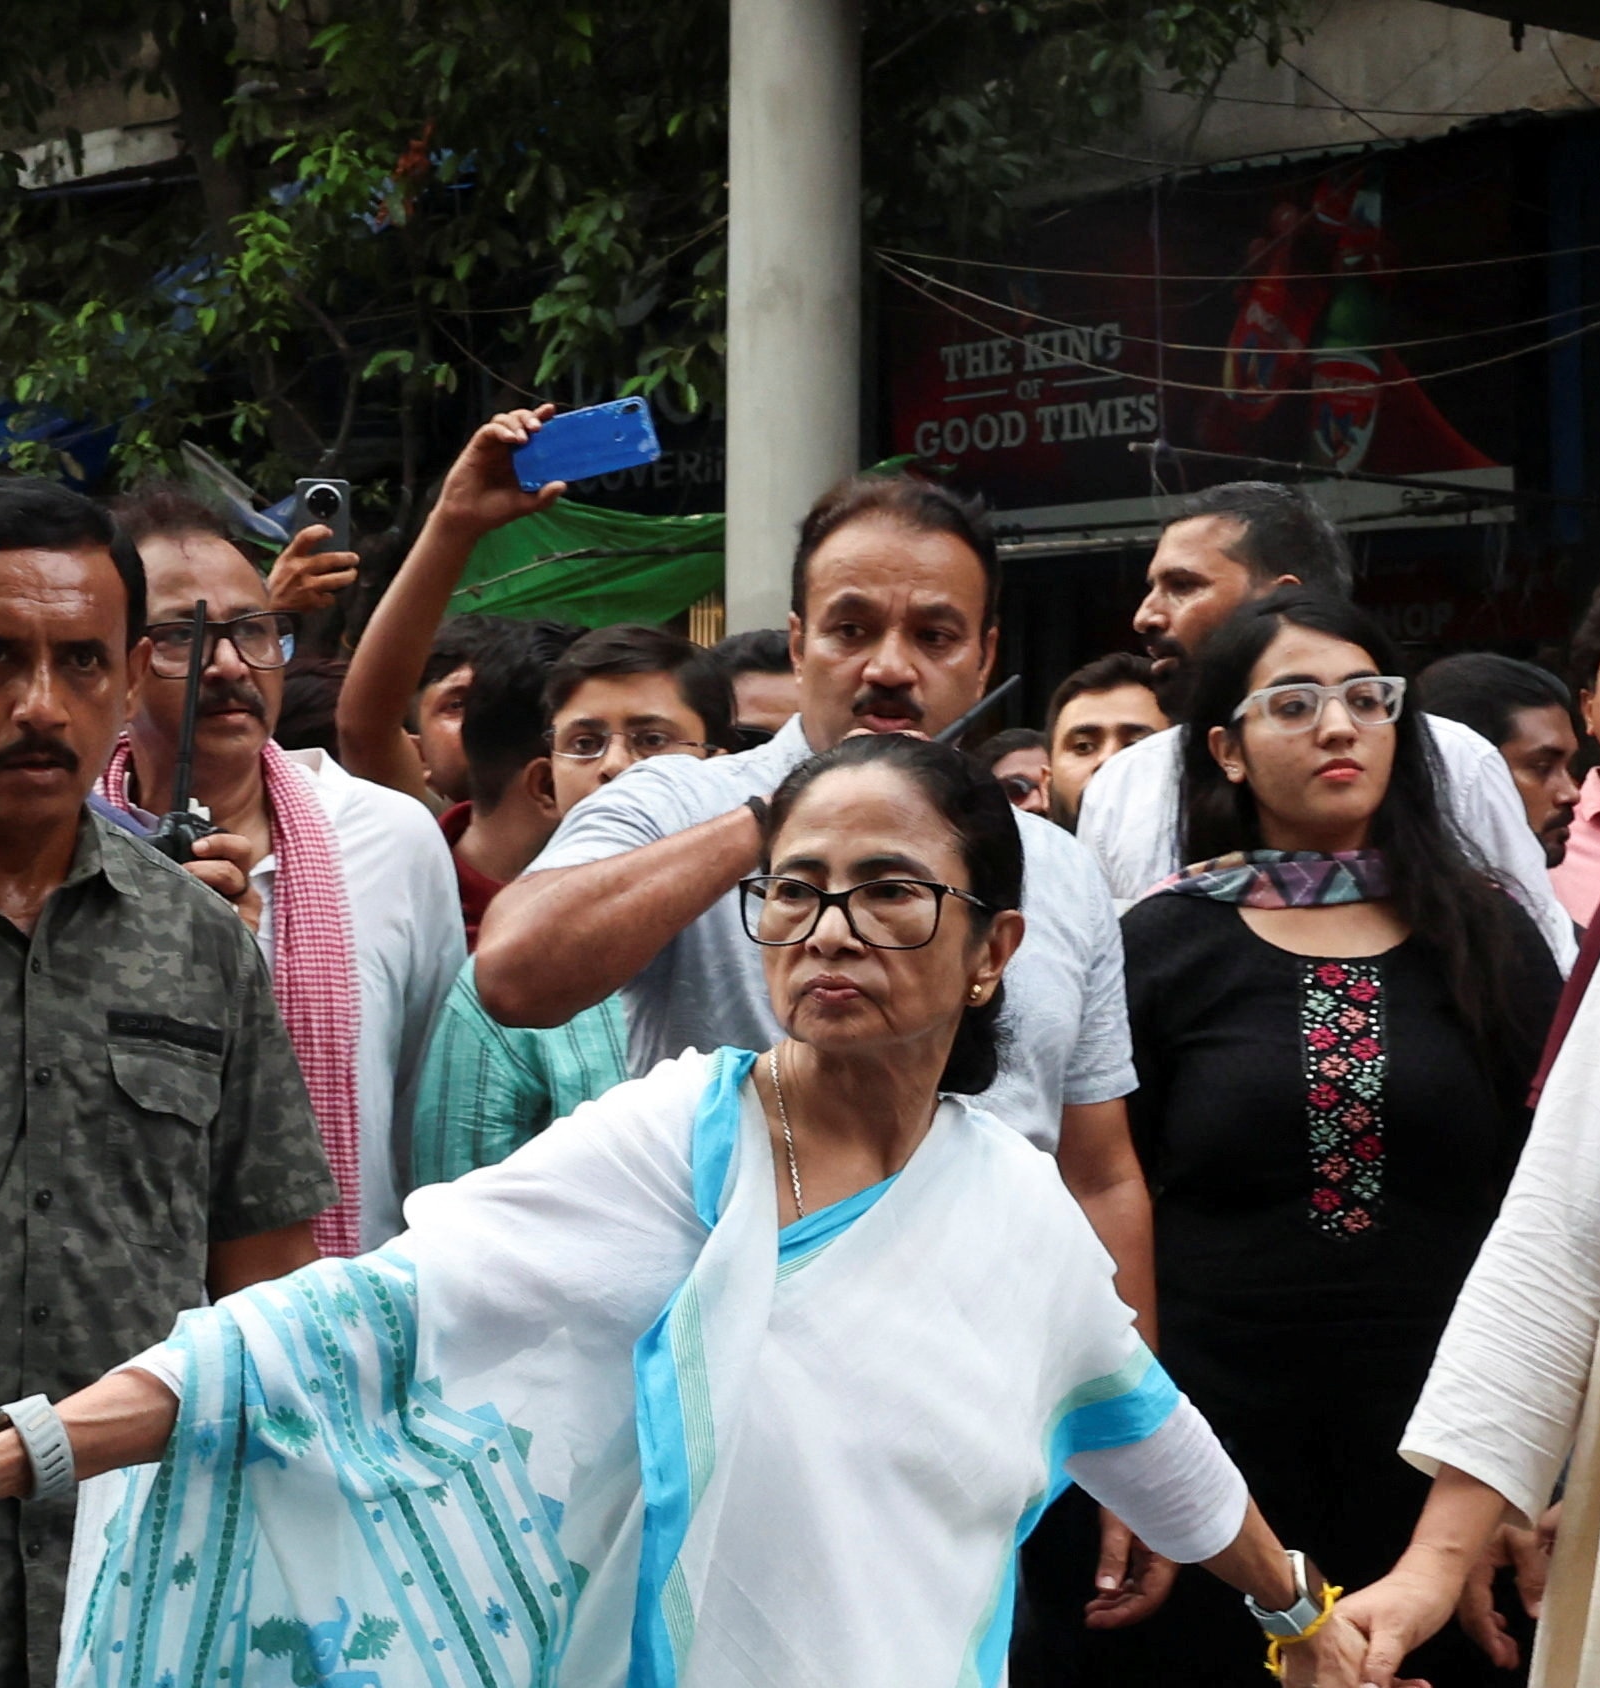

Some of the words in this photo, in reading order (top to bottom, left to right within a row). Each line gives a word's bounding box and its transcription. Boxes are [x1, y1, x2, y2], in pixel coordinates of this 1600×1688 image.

[939, 338, 1014, 383] THE
[1023, 322, 1123, 372] KING
[1016, 378, 1045, 401] OF
[914, 409, 1027, 458] GOOD
[1035, 393, 1159, 444] TIMES
